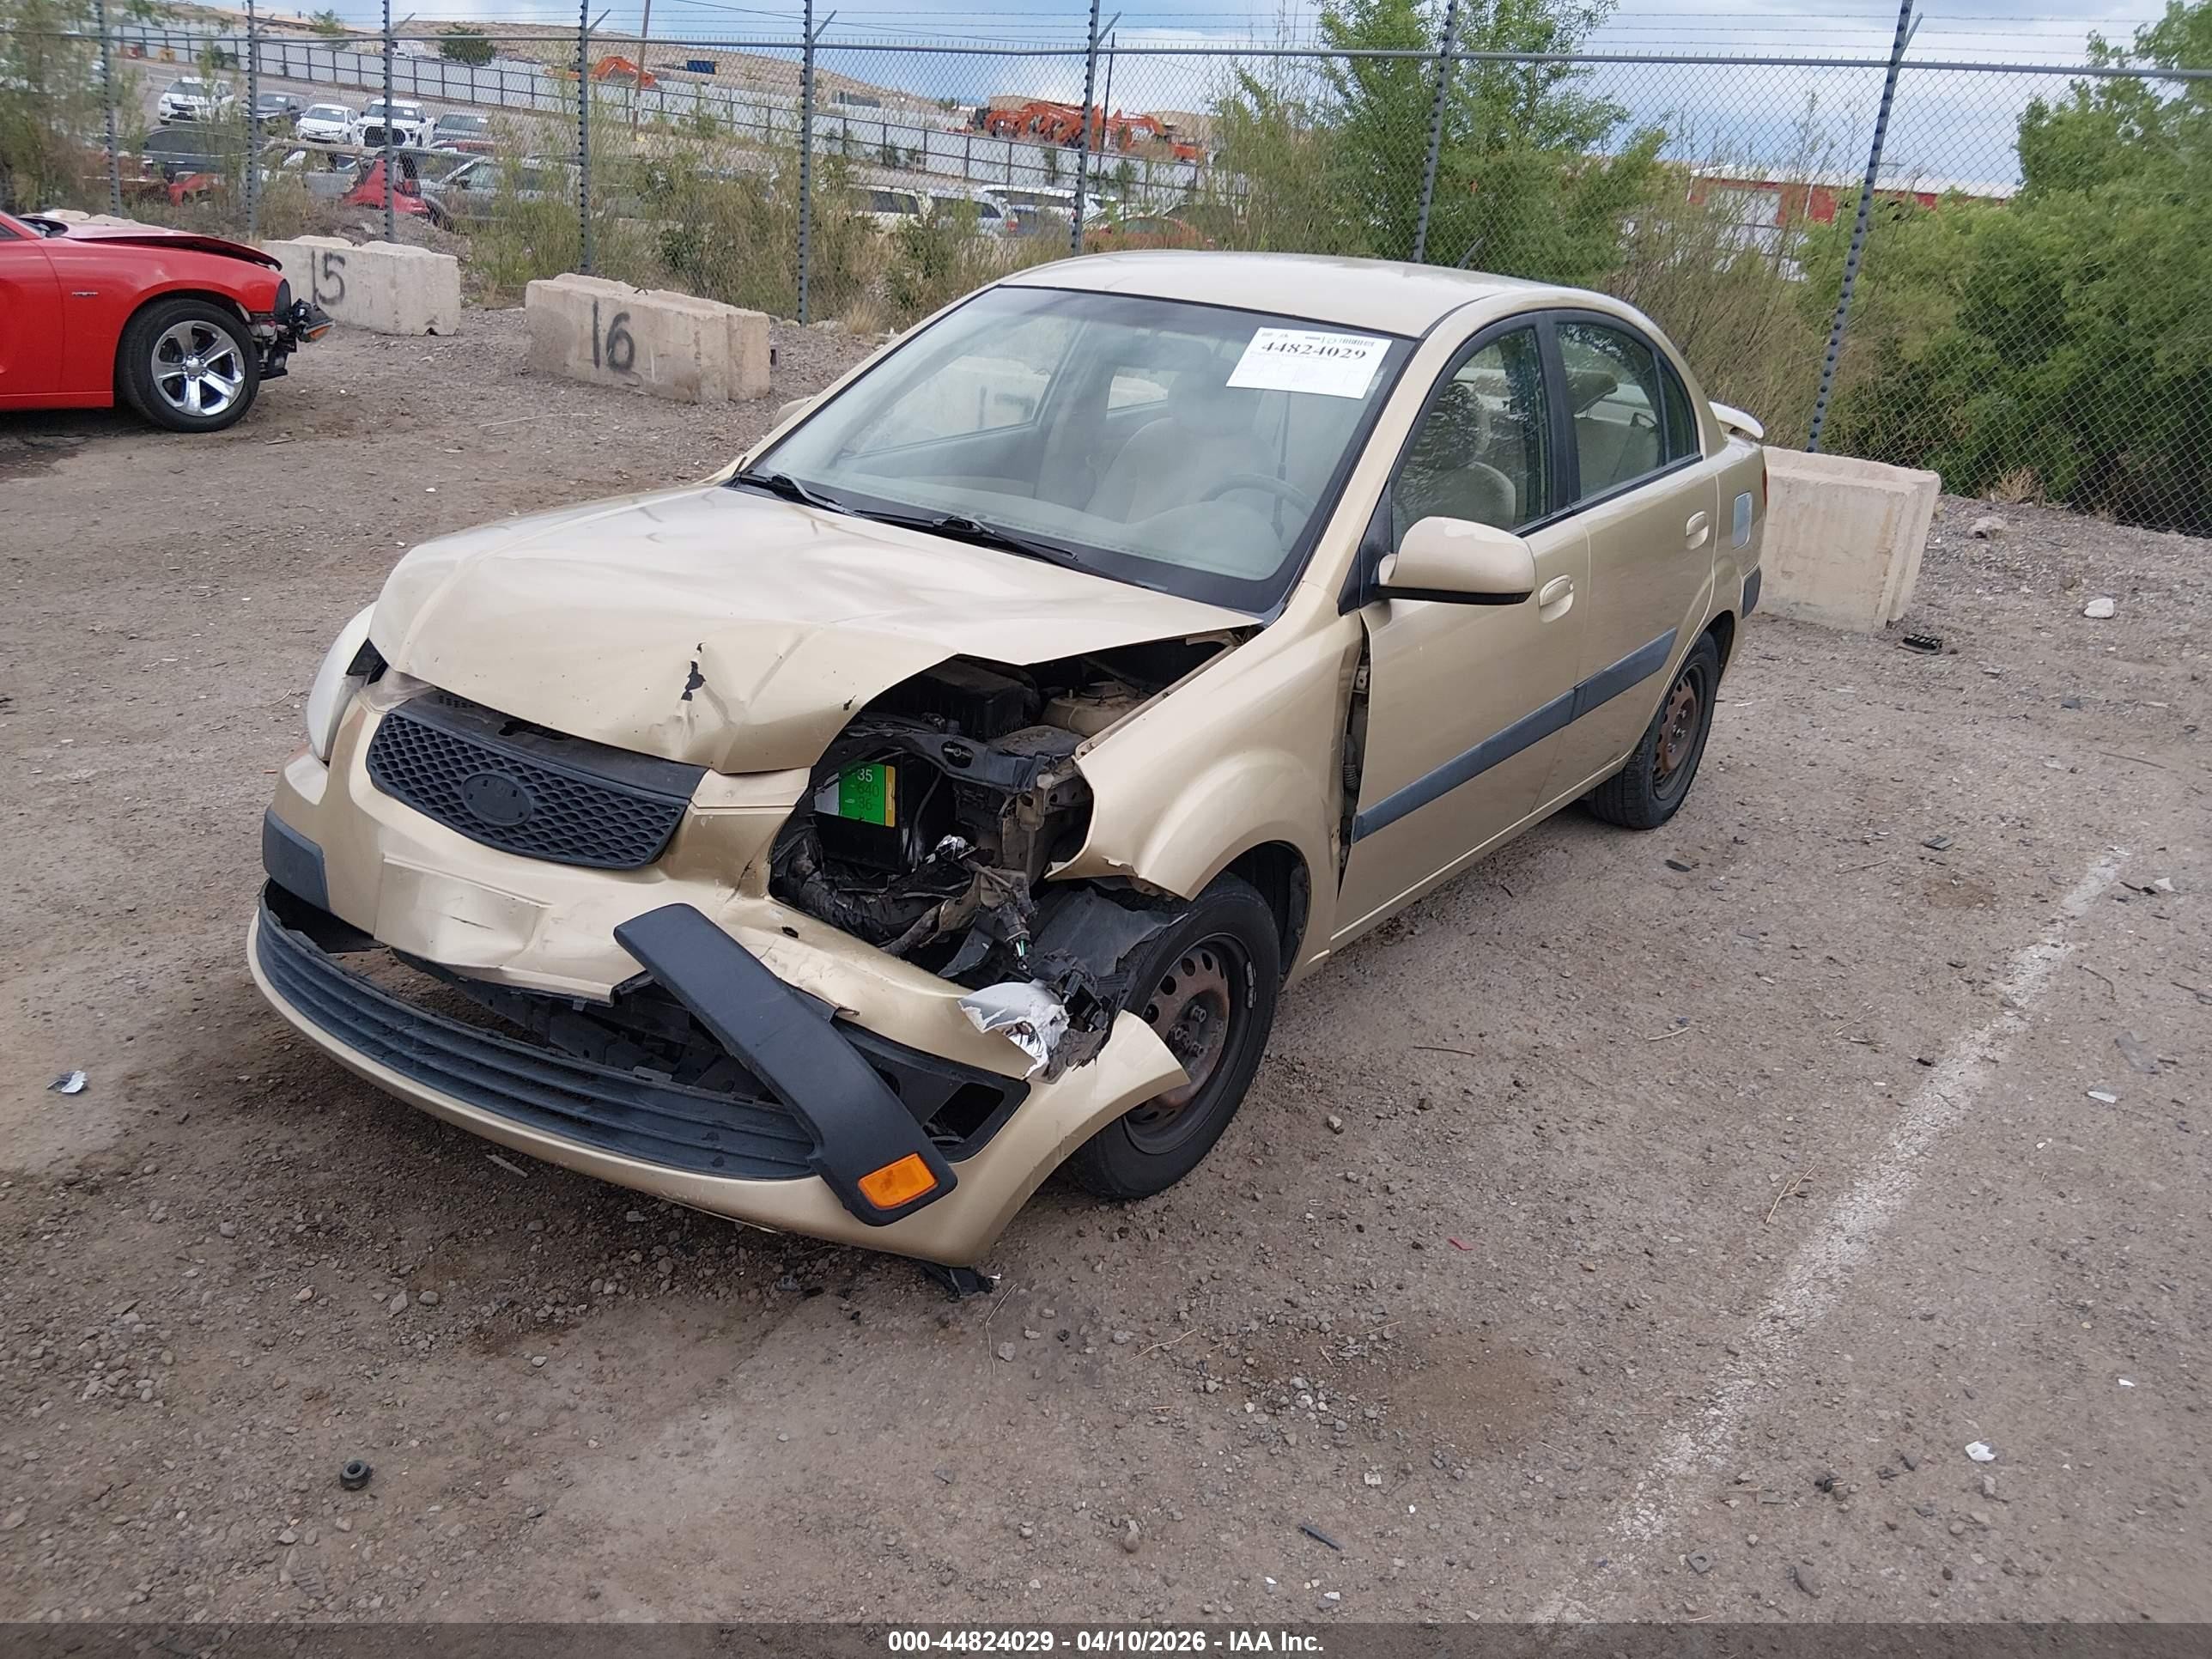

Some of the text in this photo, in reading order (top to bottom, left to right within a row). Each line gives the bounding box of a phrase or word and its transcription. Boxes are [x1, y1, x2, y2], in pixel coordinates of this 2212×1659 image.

[311, 249, 346, 307] 15
[592, 300, 635, 373] 16
[1261, 341, 1367, 360] 44824029
[857, 768, 873, 783] 35
